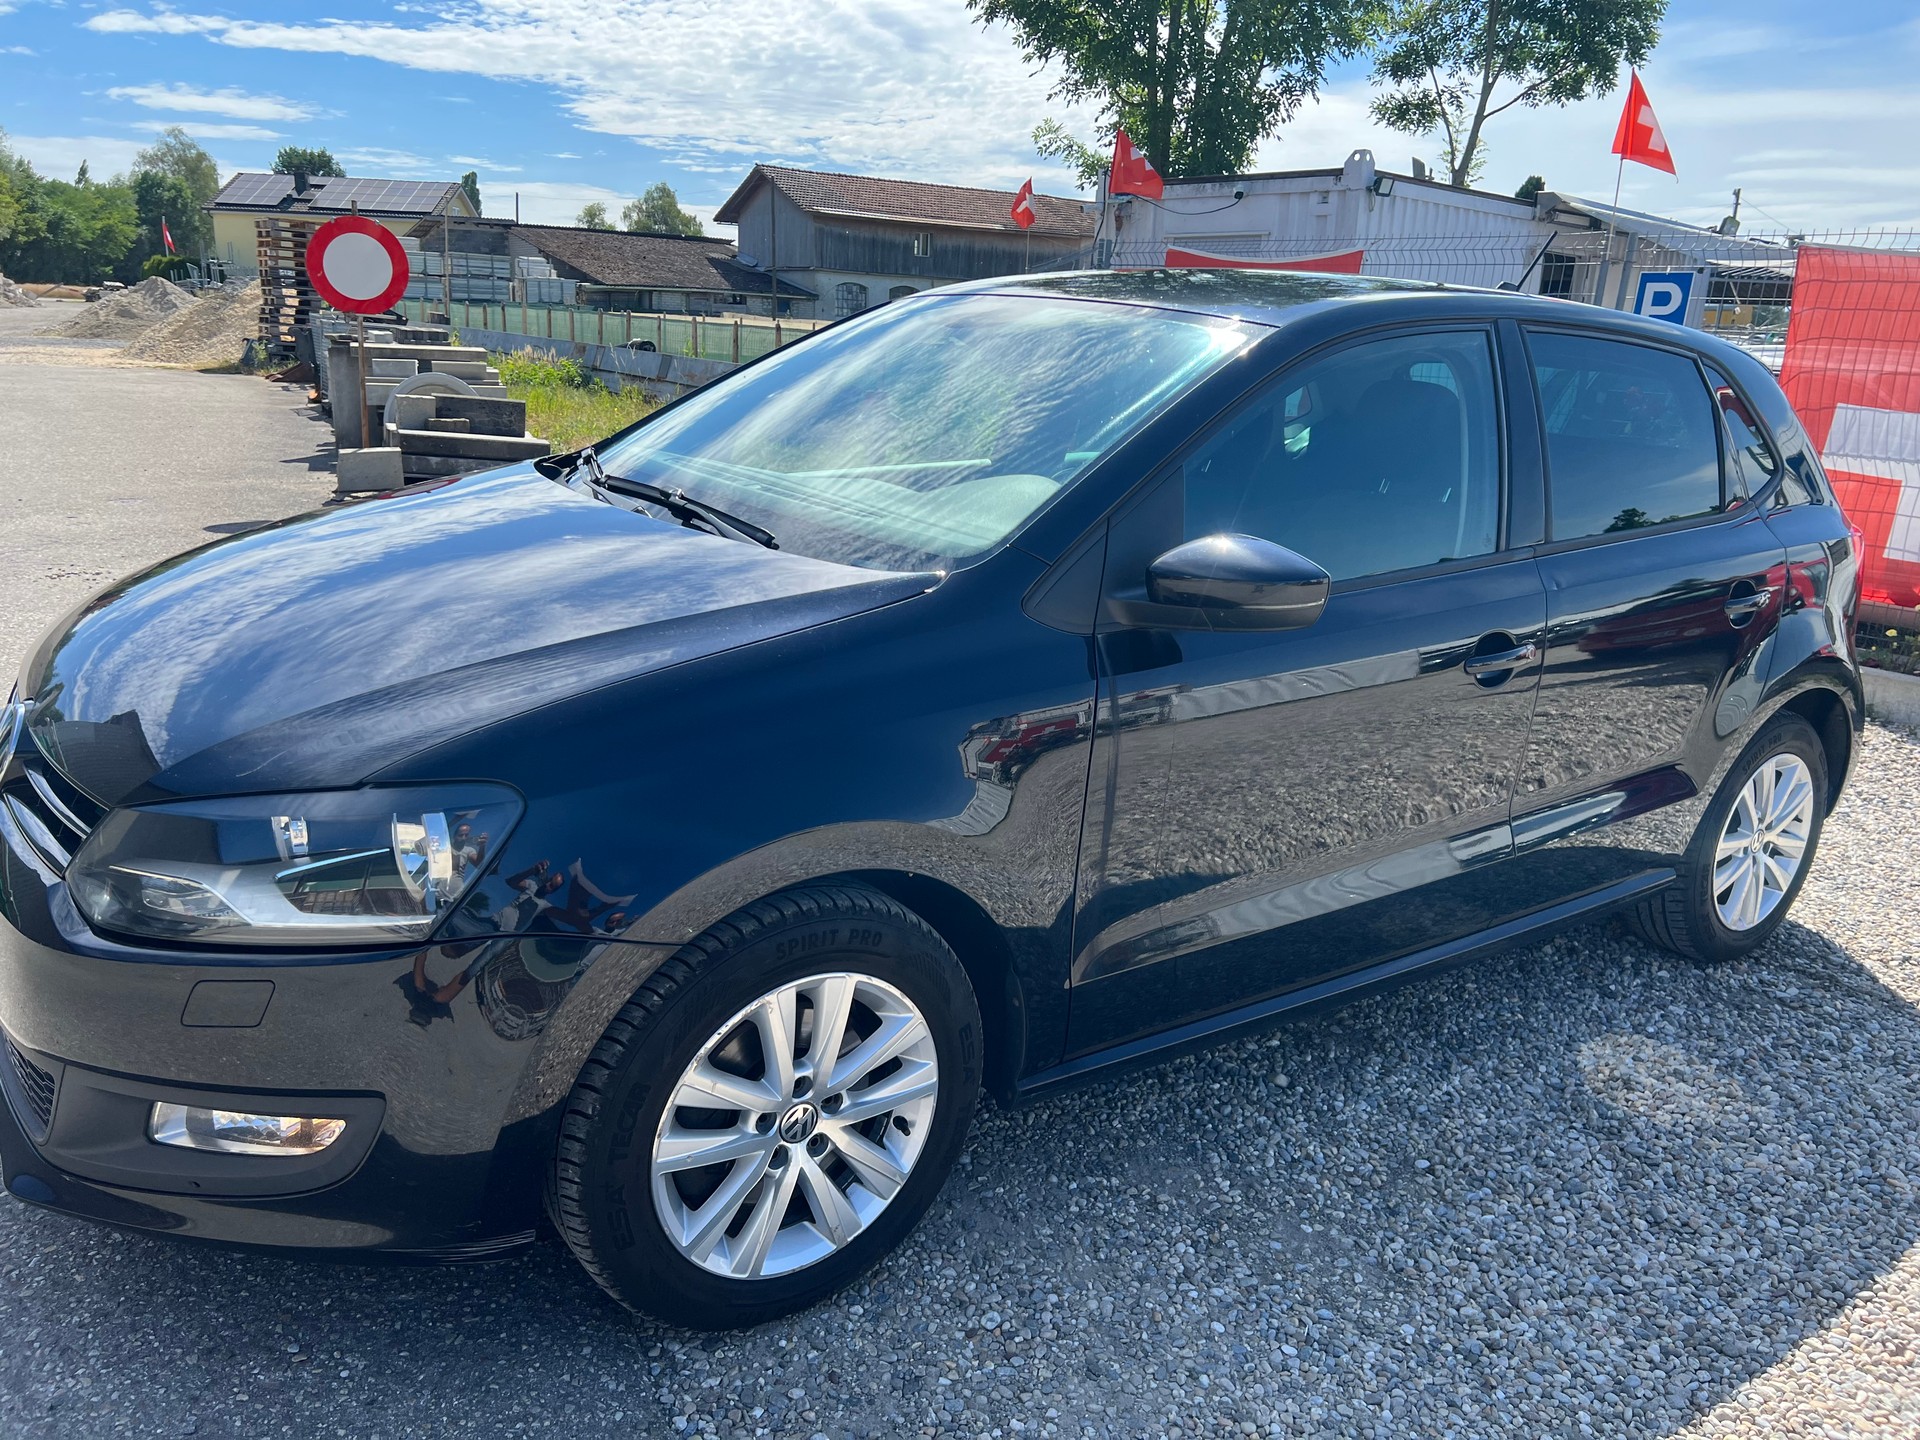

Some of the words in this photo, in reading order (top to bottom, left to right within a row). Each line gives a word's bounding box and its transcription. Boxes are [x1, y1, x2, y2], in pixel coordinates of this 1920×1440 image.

[1641, 282, 1683, 317] P
[775, 928, 839, 961] SPIRIT
[848, 928, 883, 948] PRO
[606, 1081, 652, 1166] TECAR
